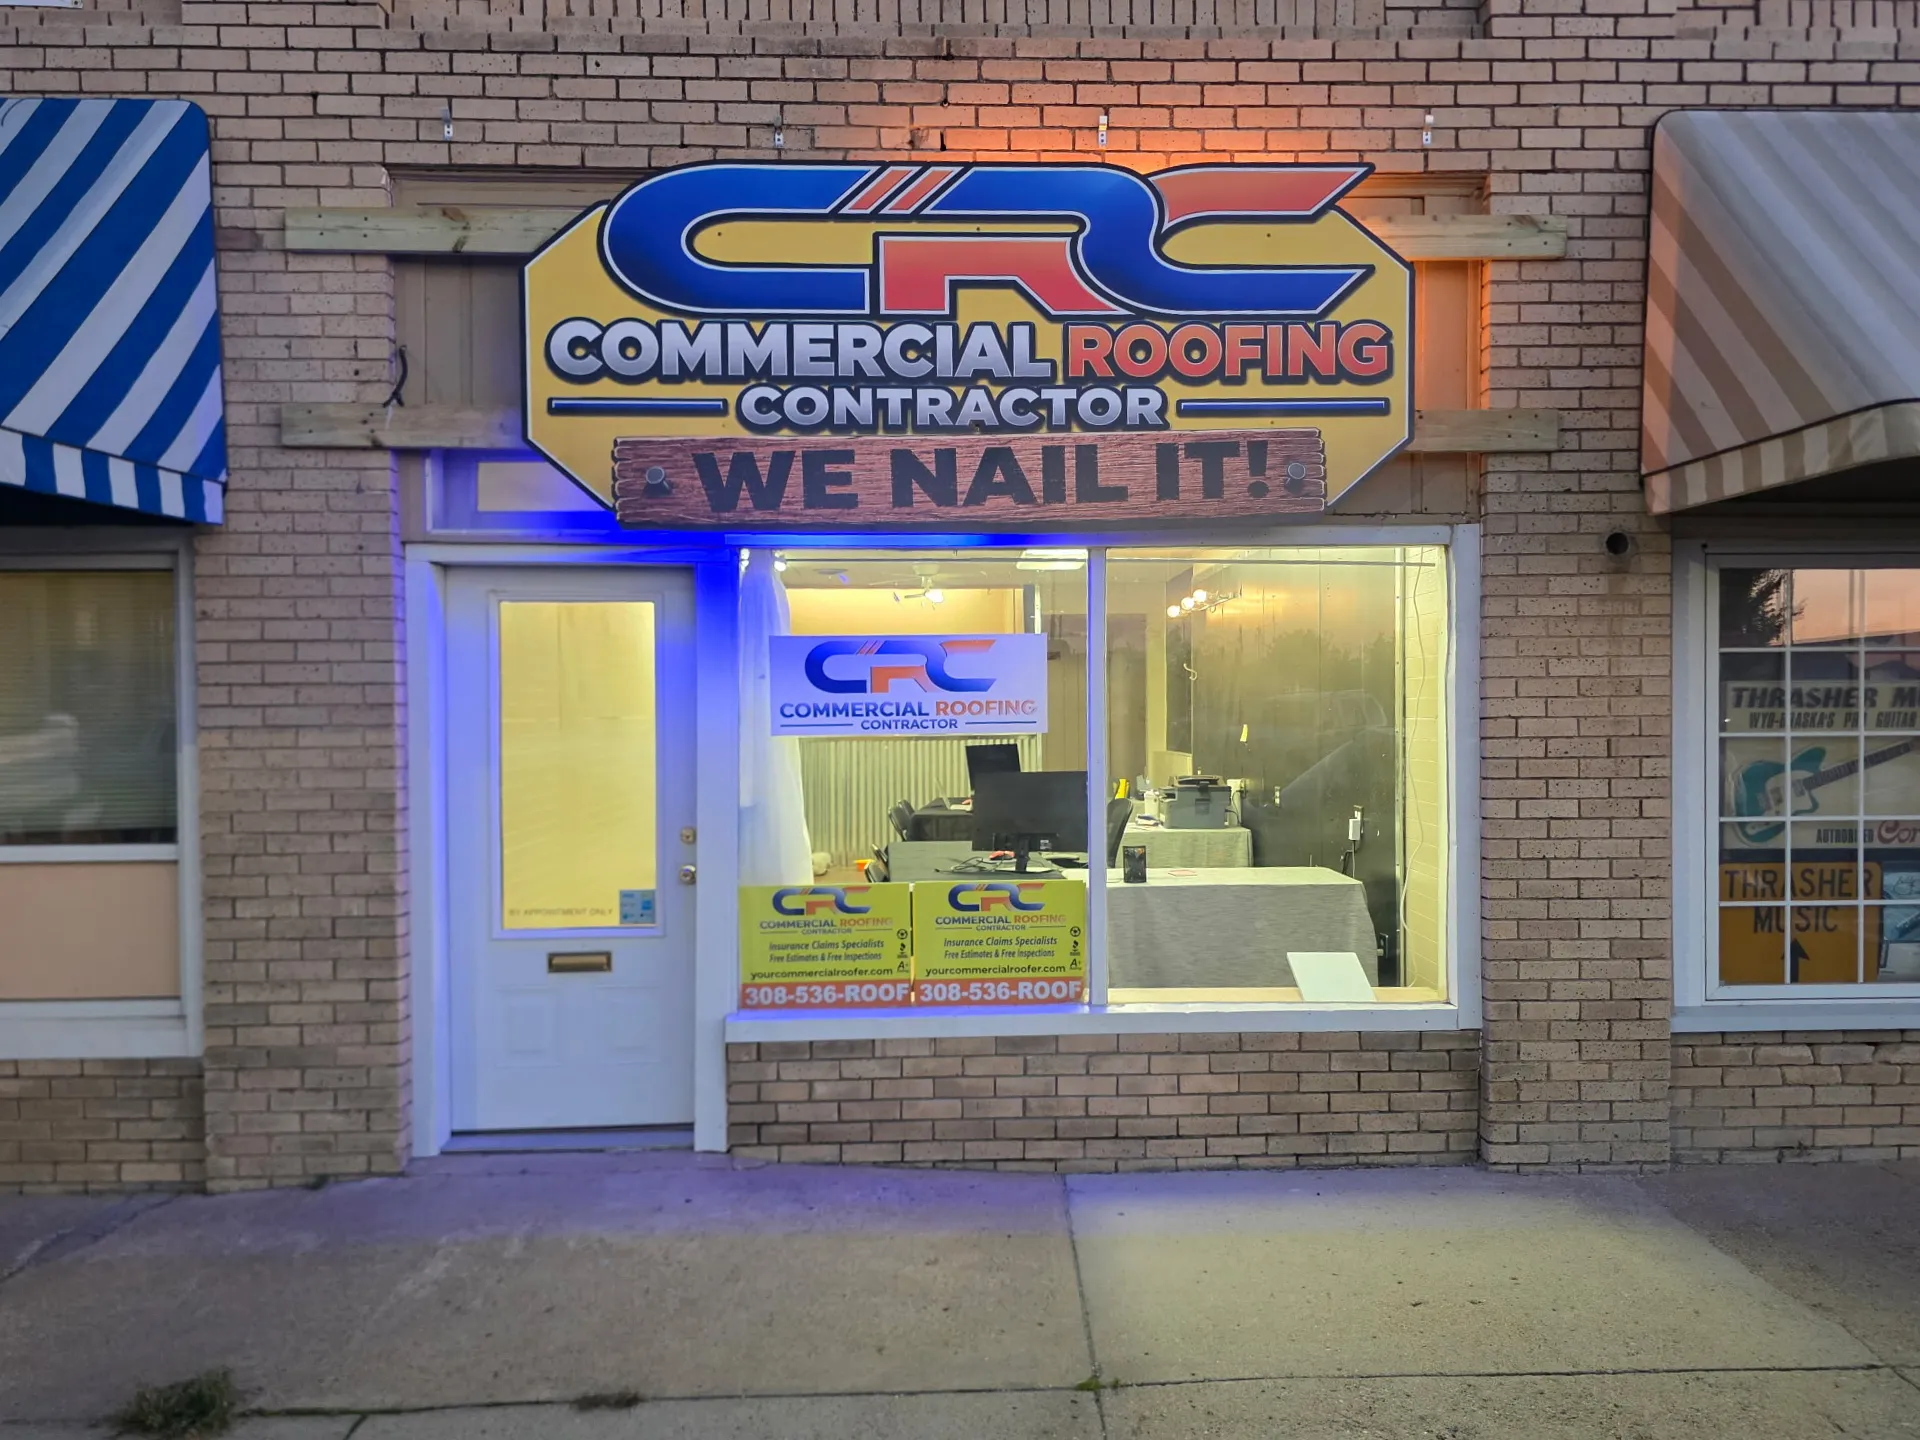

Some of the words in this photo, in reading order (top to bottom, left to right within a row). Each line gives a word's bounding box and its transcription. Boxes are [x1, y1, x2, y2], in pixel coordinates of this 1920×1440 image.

[602, 163, 1374, 317] CRC
[547, 322, 1052, 382] COMMERCIAL
[1067, 322, 1390, 380] ROOFING
[740, 386, 1164, 428] CONTRACTOR
[692, 449, 858, 512] WE
[891, 443, 1129, 508] NAIL
[1156, 440, 1269, 502] IT!
[804, 639, 996, 693] CRC
[1731, 686, 1878, 708] THRASHER
[1891, 686, 1920, 708] M
[779, 701, 930, 718] COMMERCIAL
[935, 699, 1038, 716] ROOFING
[861, 718, 958, 730] CONTRACTOR
[1875, 711, 1918, 729] GUITAR
[1816, 828, 1874, 844] AUTHORIED
[1725, 868, 1874, 899] THRASHER
[772, 885, 871, 916] CRC
[948, 883, 1045, 912] CRC
[760, 919, 837, 930] COMMERCIAL
[840, 917, 893, 927] ROOFING
[935, 915, 1011, 925] COMMERCIAL
[1014, 914, 1066, 924] ROOFING
[1753, 905, 1839, 934] MUSIC
[769, 941, 809, 951] Insurance
[812, 940, 840, 949] Claims
[841, 939, 884, 950] Specialists
[944, 937, 984, 947] Insurance
[986, 937, 1013, 946] Claims
[1015, 936, 1058, 946] Specialists
[769, 953, 784, 962] Free
[786, 953, 819, 962] Estimates
[820, 952, 826, 961] &
[827, 952, 842, 961] Free
[844, 951, 882, 962] Inspections
[944, 950, 959, 959] Free
[960, 950, 993, 959] Estimates
[994, 949, 1000, 958] &
[1001, 949, 1016, 958] Free
[1017, 948, 1055, 959] Inspections
[751, 967, 893, 981] yourcommercialroofer.com
[925, 964, 1066, 977] yourcommercialroofer.com
[745, 983, 910, 1006] 308-536-ROOF
[920, 981, 1082, 1002] 308-536-ROOF
